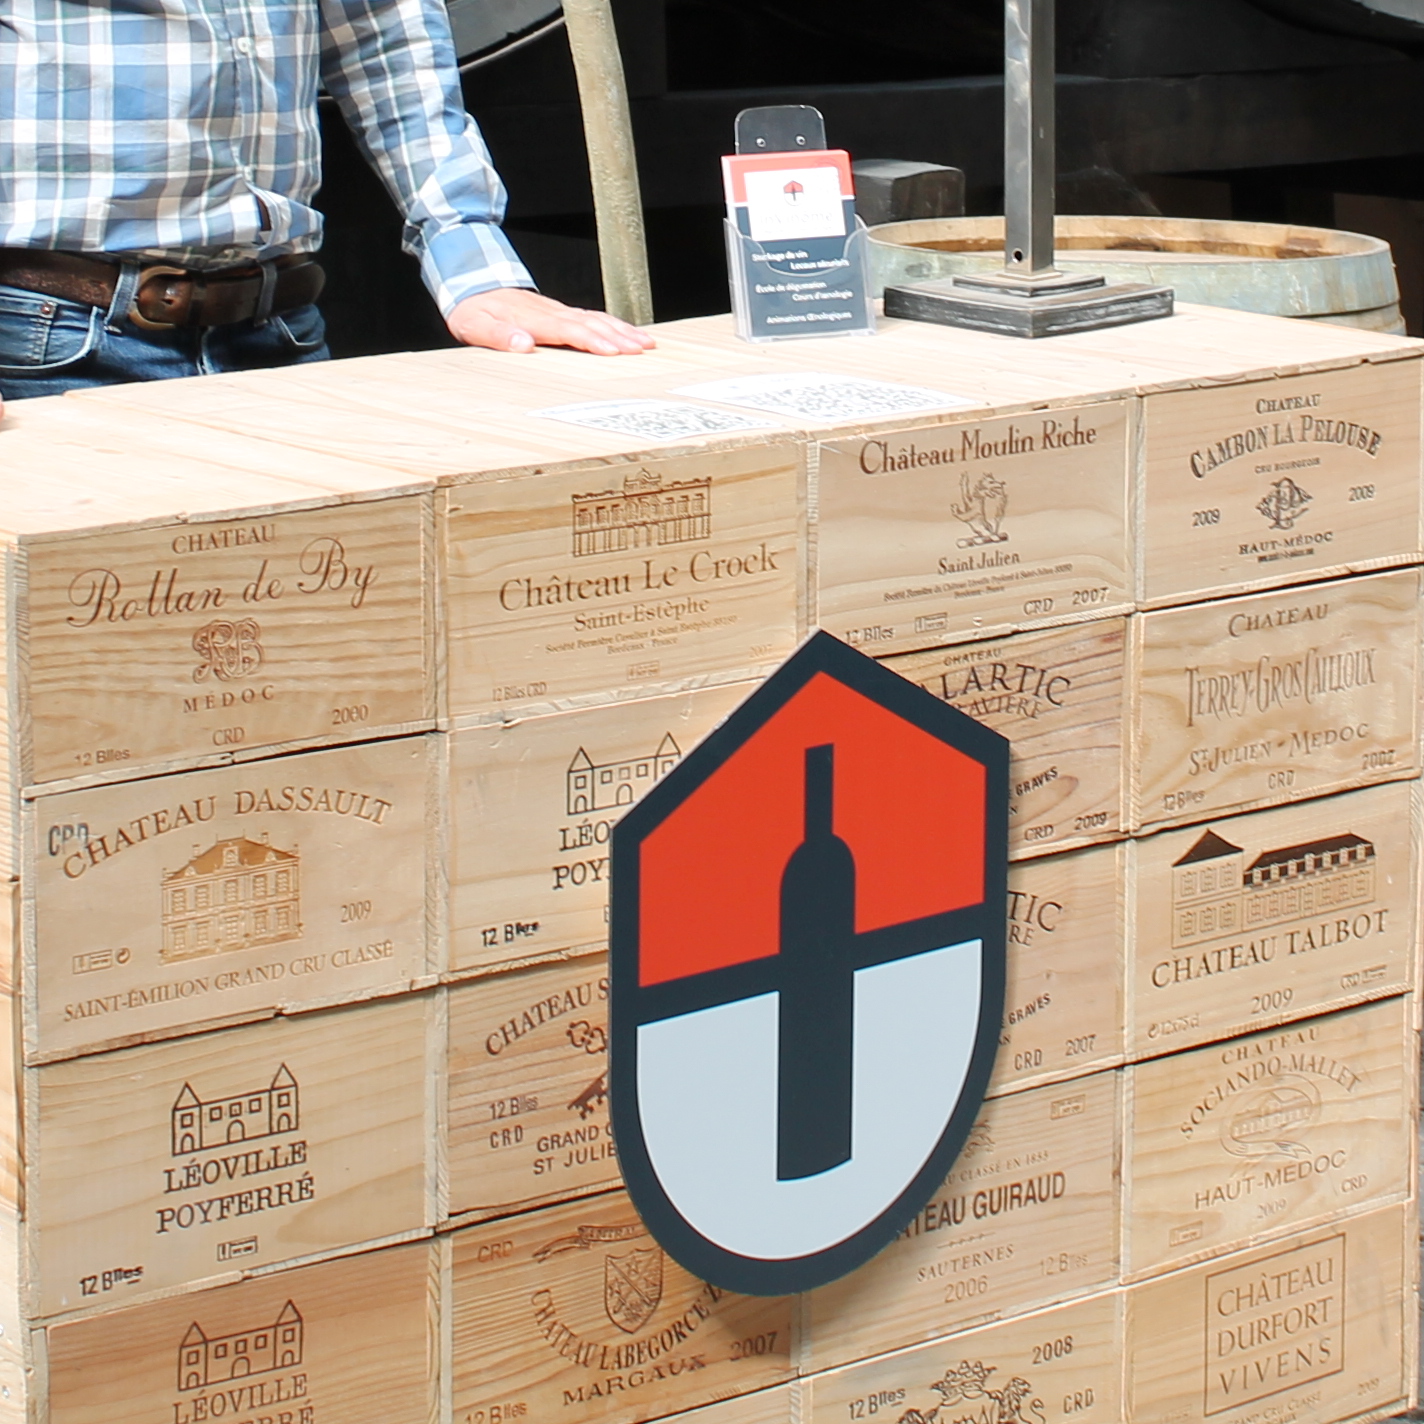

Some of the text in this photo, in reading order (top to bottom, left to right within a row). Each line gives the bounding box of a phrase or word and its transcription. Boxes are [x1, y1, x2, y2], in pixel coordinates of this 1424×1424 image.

[1255, 393, 1322, 415] CHATEAU
[859, 415, 1098, 476] Château Moulin Riche
[1188, 414, 1383, 480] CAMBON LA PELOUSE
[171, 523, 277, 555] CHATEAU
[499, 541, 781, 612] Château Le Crock
[937, 550, 1021, 576] Saint Julien
[66, 535, 380, 628] Rollan de By
[574, 597, 711, 633] Saint-Estèphe
[1023, 598, 1053, 615] CRD
[1228, 603, 1330, 638] CHATEAU
[943, 648, 1002, 667] CHATEAU
[939, 662, 1072, 707] LARTIC
[212, 726, 245, 747] CRD
[1015, 766, 1059, 796] GRAVES
[1268, 769, 1295, 790] CRD
[62, 785, 394, 880] CHATEAU DASSAULT
[1024, 823, 1054, 842] CRD
[340, 899, 373, 925] 2009
[481, 928, 498, 947] 12
[1150, 908, 1389, 988] CHATEAU TALBOT
[63, 938, 395, 1023] SAINT-ÉMILION GRAND CRU CLASSÉ
[1008, 992, 1052, 1025] GRAVES
[1250, 987, 1294, 1015] 2009
[485, 988, 591, 1057] CHATEAU
[1014, 1049, 1043, 1072] CRD
[1221, 1027, 1320, 1065] CHATEAU
[488, 1101, 504, 1120] 12
[1179, 1053, 1363, 1140] SOCIANDO-MALLET
[489, 1125, 524, 1149] CRD
[536, 1125, 601, 1153] GRAND
[163, 1140, 308, 1195] LÉOVILLE
[533, 1144, 618, 1176] ST JULIE
[1006, 1158, 1022, 1170] EN
[156, 1170, 316, 1235] POYFERRÉ
[896, 1171, 1066, 1241] TEAU GUIRAUD
[477, 1240, 514, 1264] CRD
[916, 1244, 1015, 1283] SAUTERNES
[79, 1276, 99, 1297] 12
[944, 1275, 989, 1304] 2006
[530, 1288, 710, 1371] CHATEAU LABEGORCE
[1217, 1295, 1334, 1358] DURFORT
[729, 1331, 779, 1363] 2007
[1032, 1335, 1074, 1365] 2008
[562, 1352, 707, 1407] MARGAUX
[1218, 1336, 1332, 1395] VIVENS
[172, 1372, 309, 1424] LÉOVILLE
[849, 1400, 865, 1421] 12
[1063, 1388, 1095, 1414] CRD
